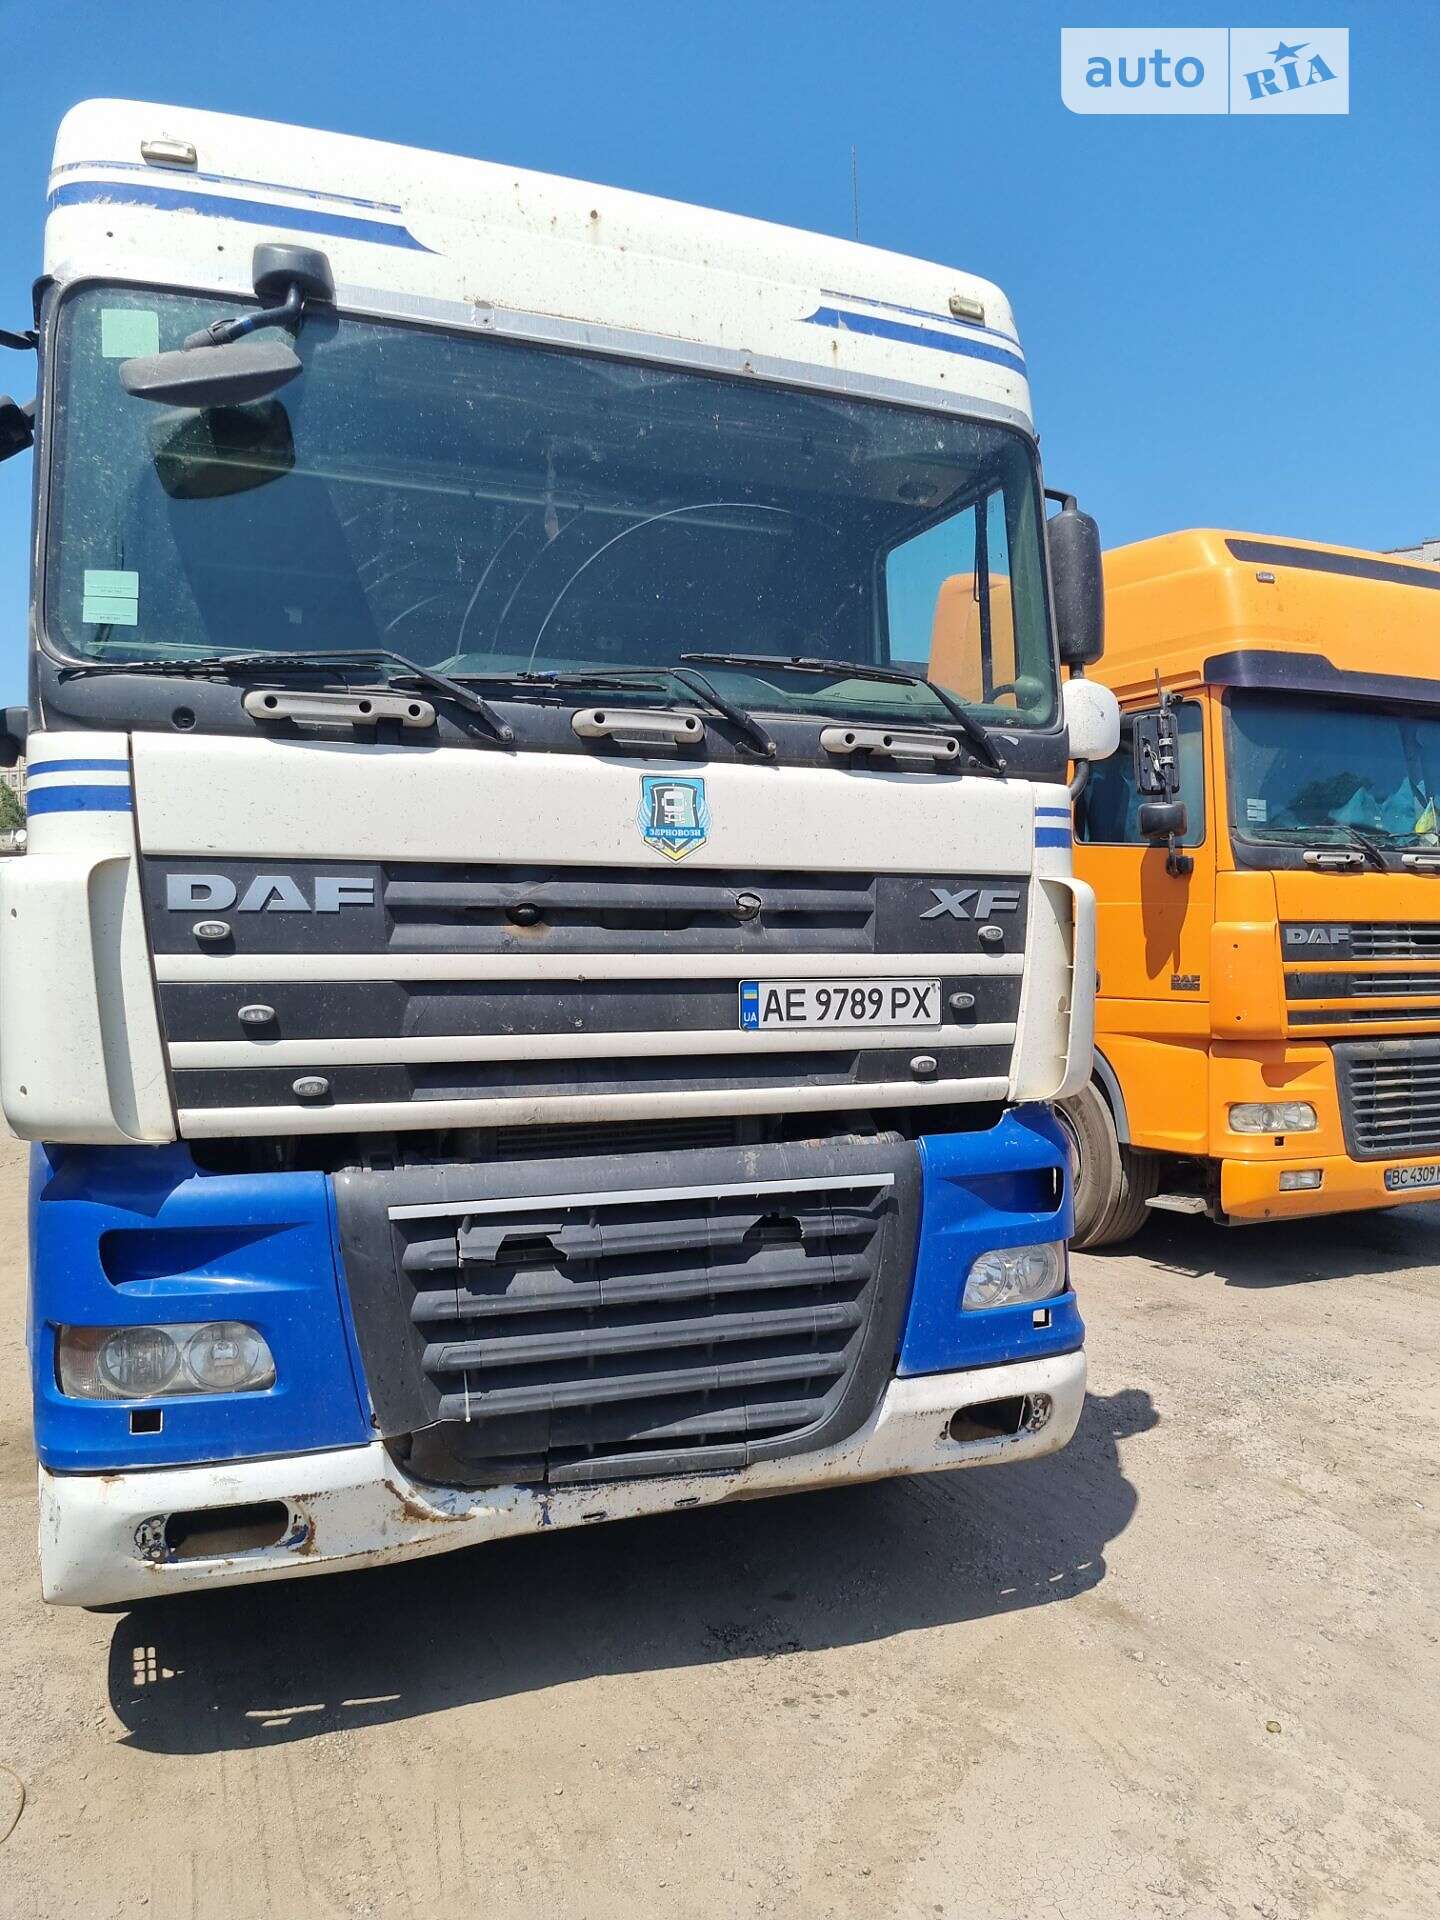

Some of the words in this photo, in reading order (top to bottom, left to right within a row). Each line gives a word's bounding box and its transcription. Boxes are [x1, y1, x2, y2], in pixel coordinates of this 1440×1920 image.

[166, 874, 374, 914] DAF
[920, 888, 1020, 920] XF
[1286, 928, 1350, 945] DAF
[743, 1011, 758, 1022] UA
[762, 989, 807, 1022] AE
[815, 988, 884, 1021] 9789
[890, 987, 932, 1019] PX
[1392, 1169, 1408, 1185] BC
[1410, 1166, 1435, 1182] 4309
